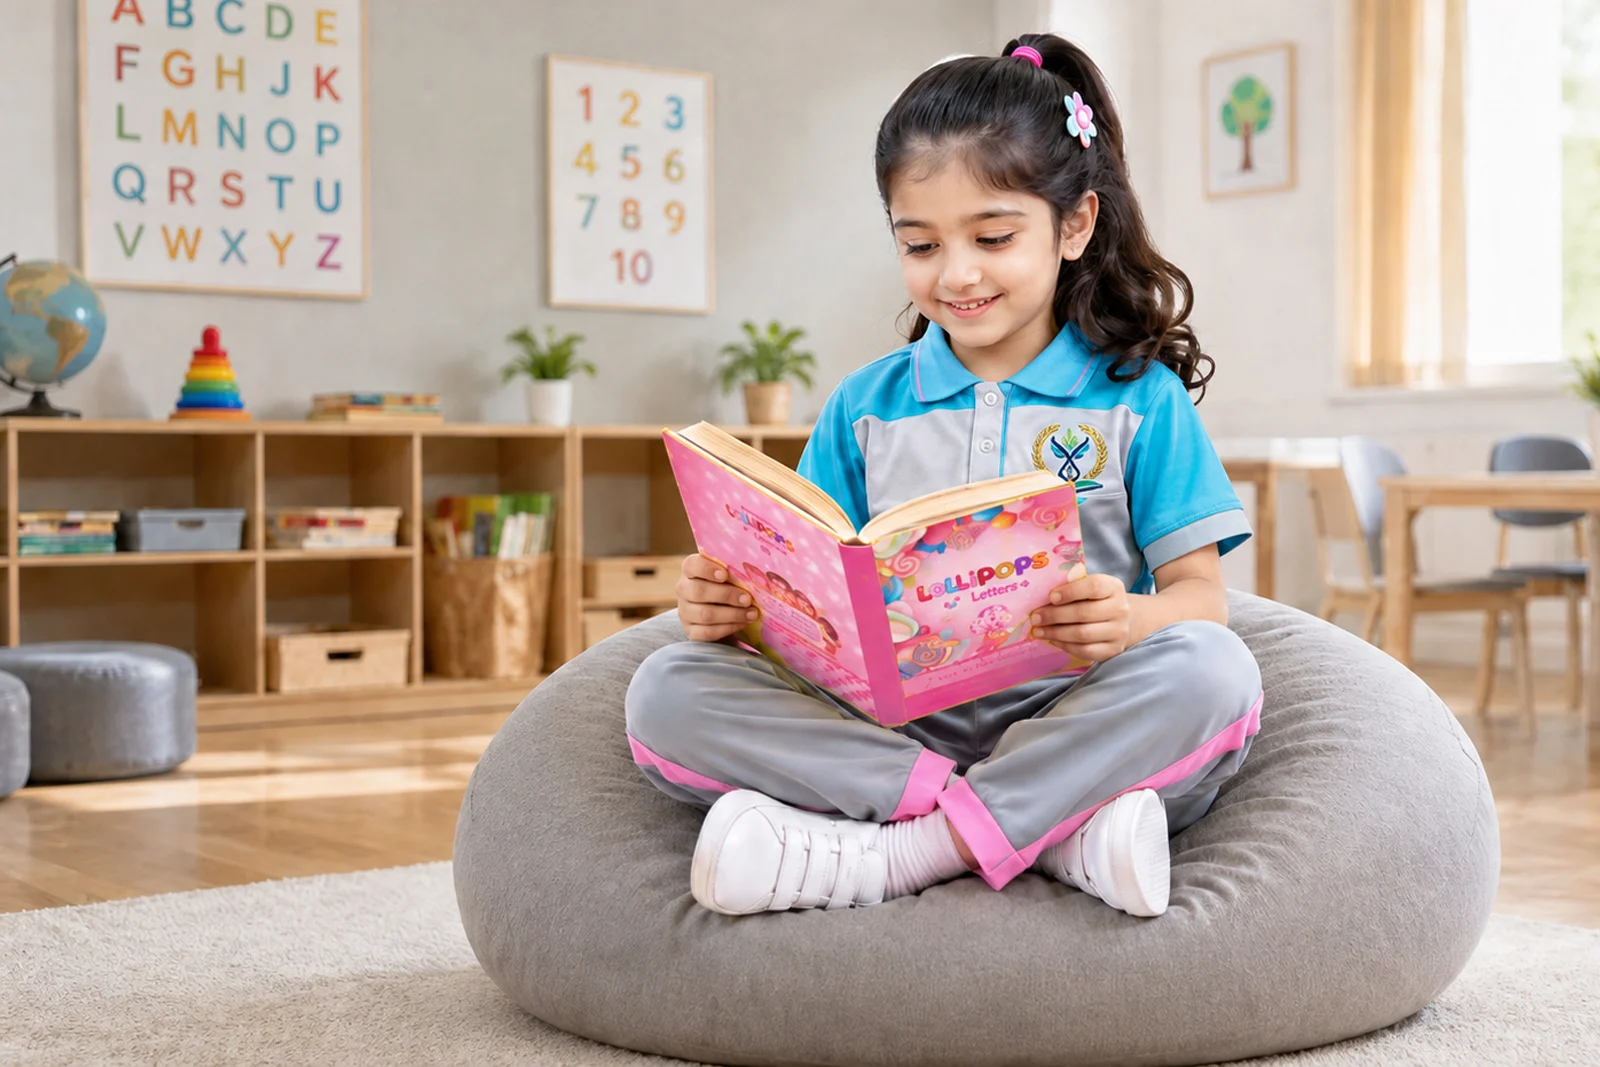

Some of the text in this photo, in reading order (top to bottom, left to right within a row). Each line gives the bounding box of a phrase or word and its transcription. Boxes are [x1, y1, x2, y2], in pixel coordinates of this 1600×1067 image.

[111, 0, 338, 45] A B C D E
[115, 44, 341, 103] F G H J K
[116, 103, 341, 157] L M N O P
[576, 85, 684, 131] 1 2 3
[574, 142, 685, 183] 4 5 6
[112, 163, 341, 214] Q R S T U
[576, 193, 685, 235] 7 8 9
[114, 221, 342, 271] V W X Y Z
[611, 248, 653, 285] 10
[971, 582, 1018, 602] Letters
